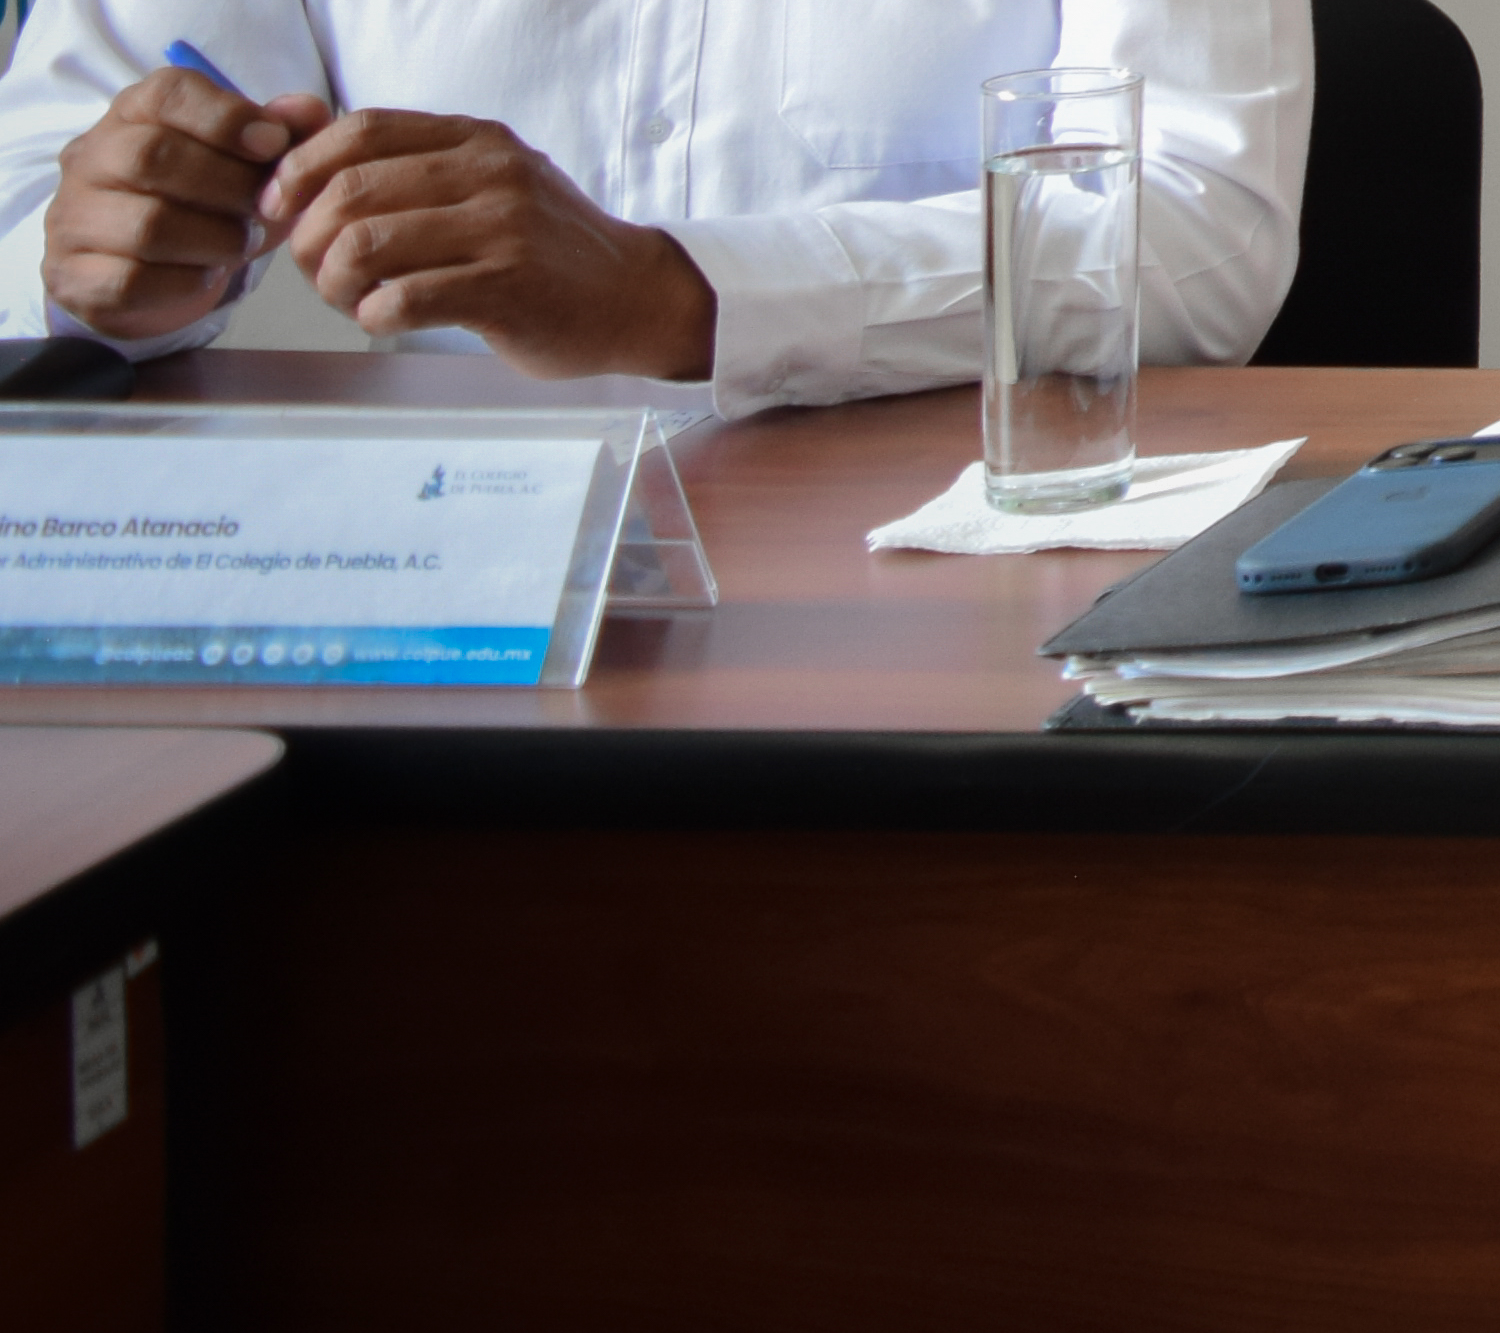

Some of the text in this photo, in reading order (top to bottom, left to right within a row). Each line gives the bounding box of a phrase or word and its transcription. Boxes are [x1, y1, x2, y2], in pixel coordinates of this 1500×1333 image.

[41, 516, 117, 539] Barco
[120, 514, 240, 539] Atanacio
[12, 551, 161, 572] Administrativo
[165, 552, 192, 572] de
[214, 551, 292, 576] Colegio
[294, 552, 321, 572] de
